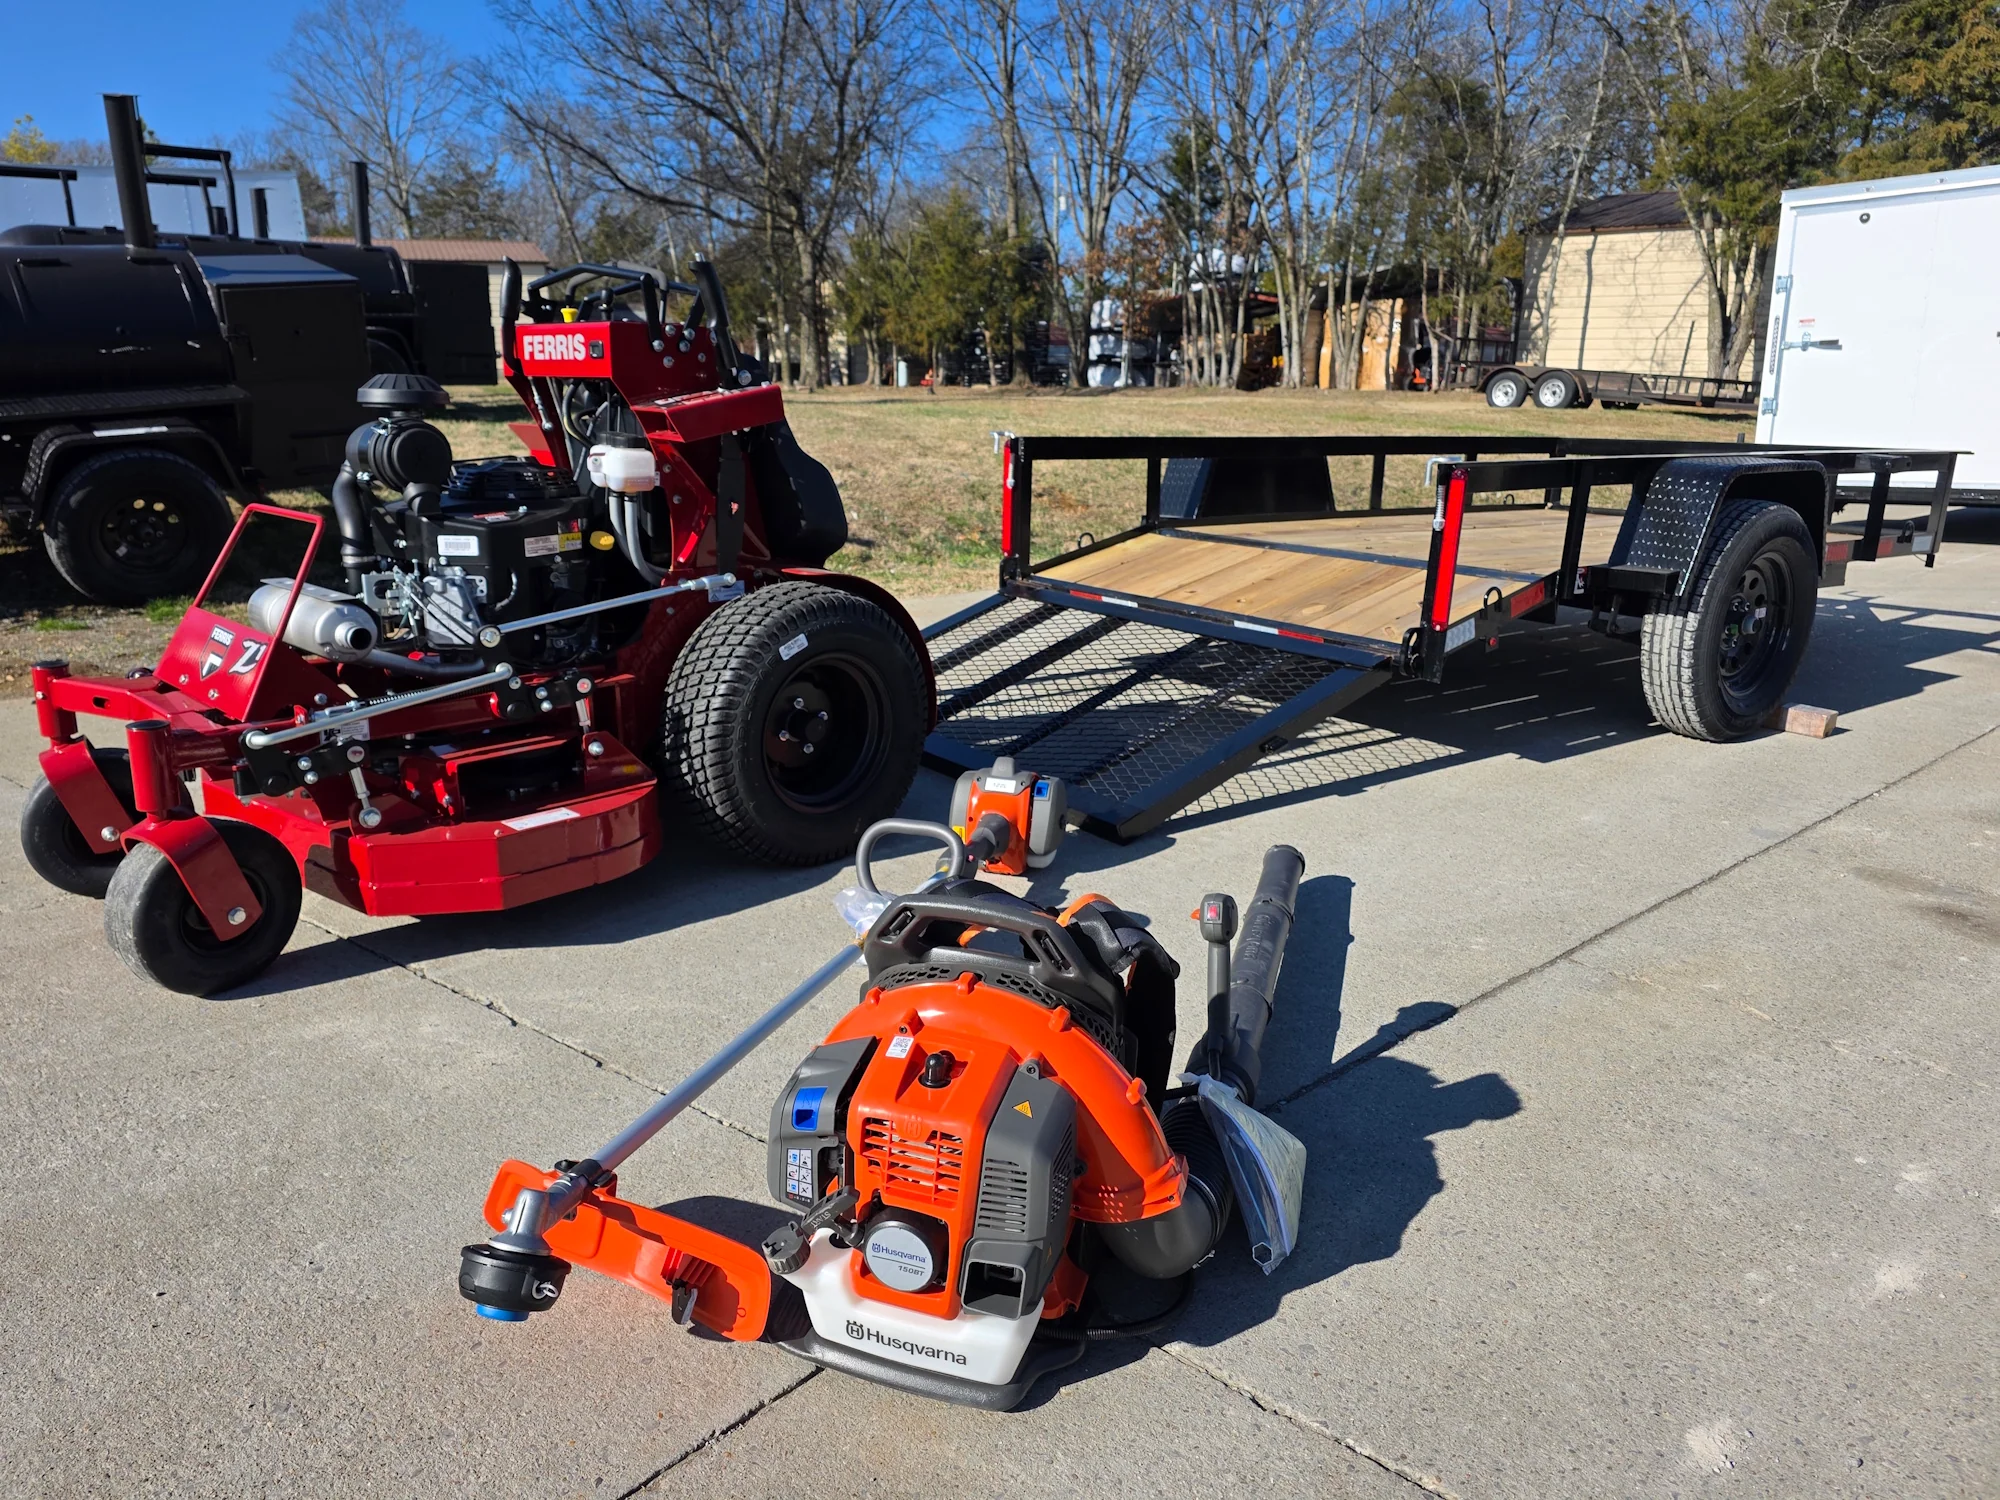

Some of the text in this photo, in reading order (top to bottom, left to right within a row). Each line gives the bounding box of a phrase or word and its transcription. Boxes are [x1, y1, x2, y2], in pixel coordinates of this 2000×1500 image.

[522, 333, 586, 361] FERRIS
[810, 1211, 831, 1229] START
[881, 1246, 926, 1263] Husqvarna
[898, 1265, 925, 1277] 150BT
[867, 1328, 967, 1366] Husqvarna
